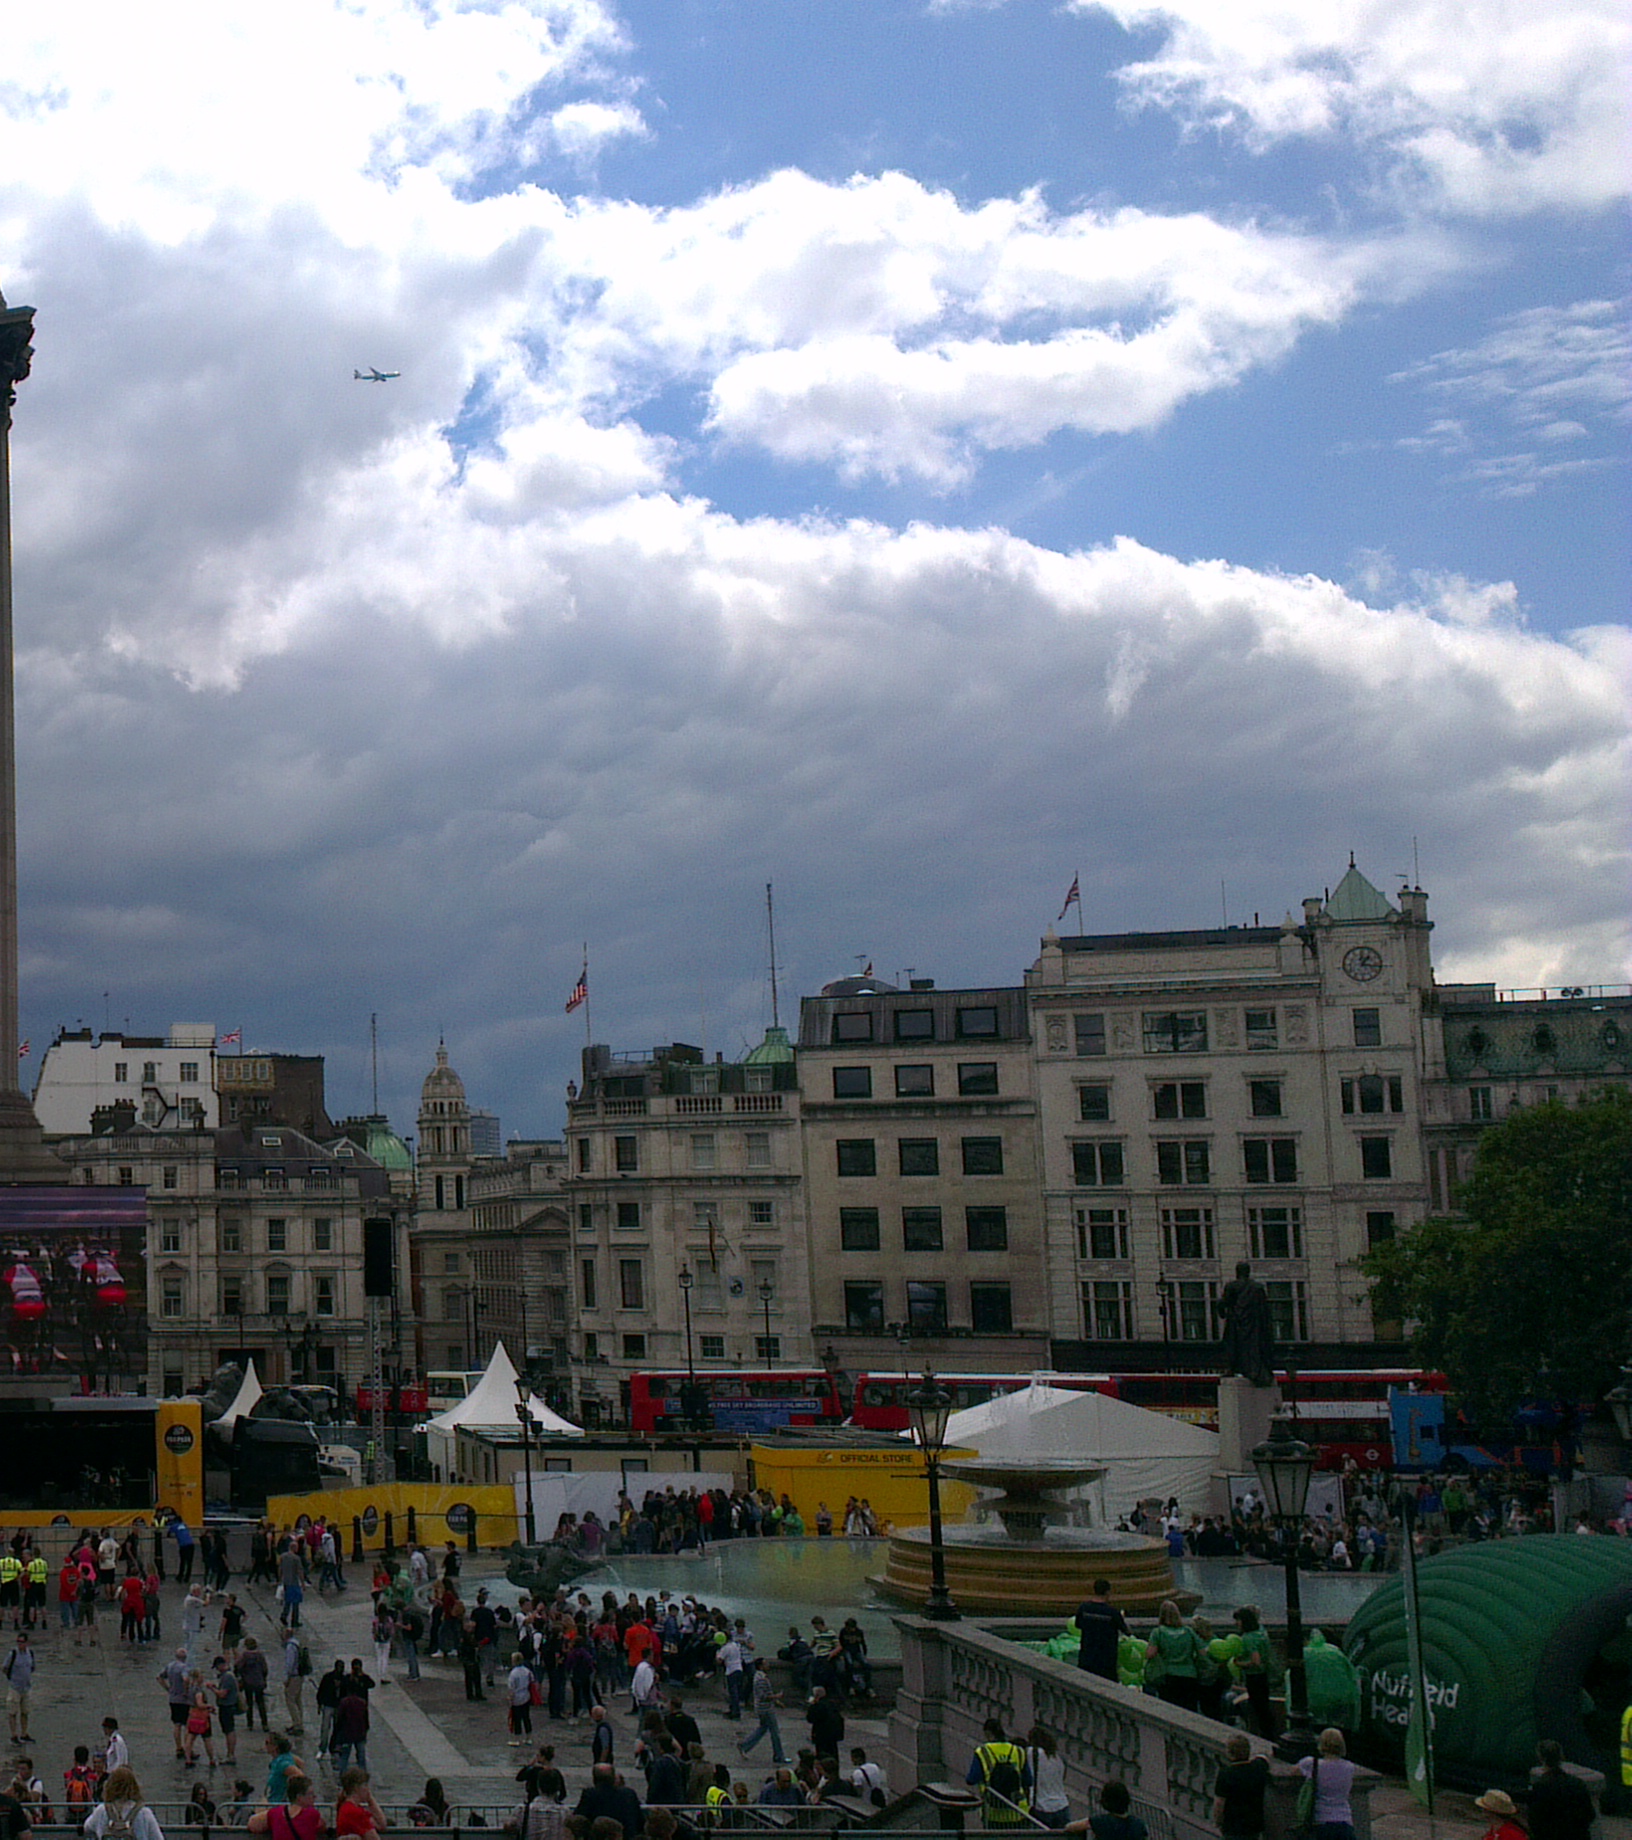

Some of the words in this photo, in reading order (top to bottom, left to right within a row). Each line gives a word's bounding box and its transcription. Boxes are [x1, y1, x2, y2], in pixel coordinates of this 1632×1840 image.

[840, 1454, 880, 1463] OFFICIAL
[882, 1454, 913, 1463] STORE
[1371, 1671, 1461, 1709] Nufeld
